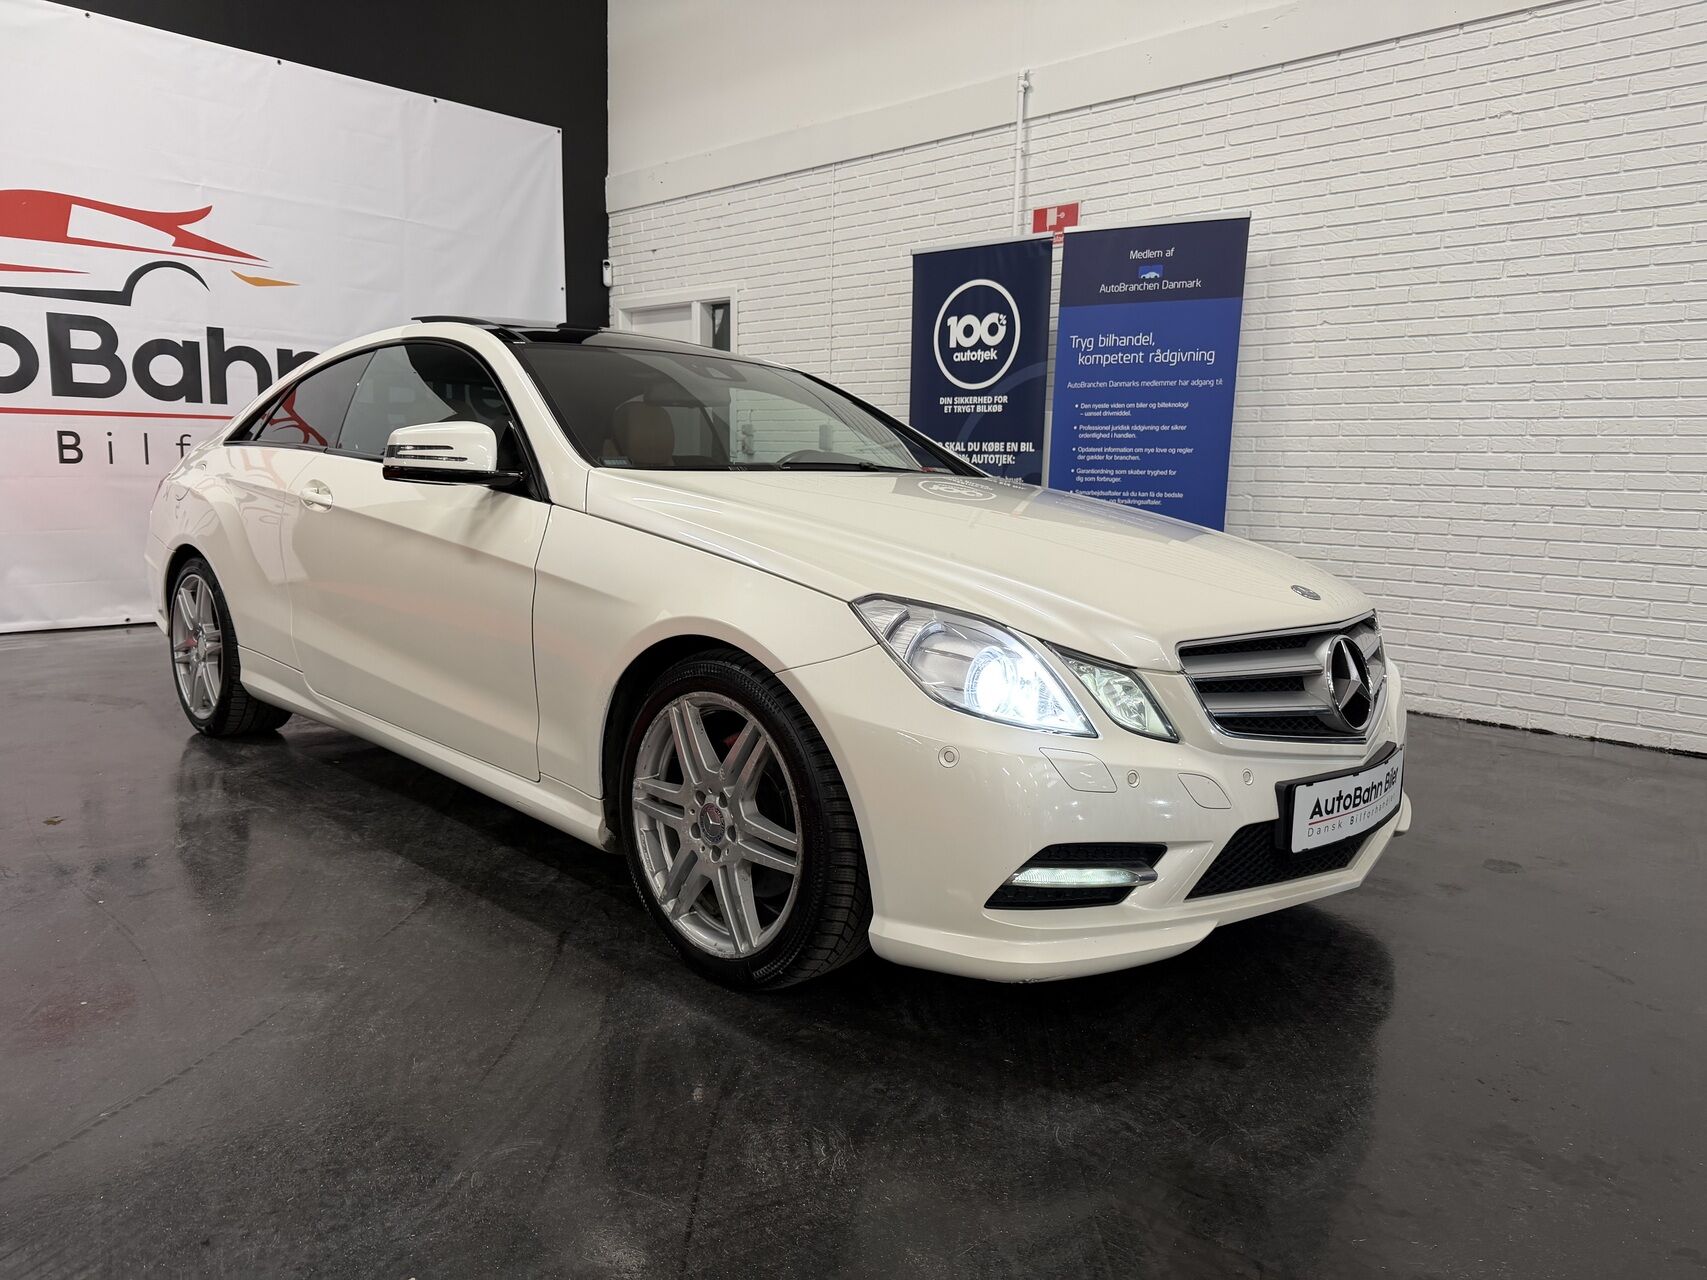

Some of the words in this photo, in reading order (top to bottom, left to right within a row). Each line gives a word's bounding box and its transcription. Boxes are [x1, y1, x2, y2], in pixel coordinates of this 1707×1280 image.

[1130, 249, 1163, 260] Medlem
[1166, 247, 1176, 258] af
[1099, 280, 1160, 293] AutoBranchen
[1162, 278, 1202, 290] Danmark
[1070, 335, 1094, 352] Tryg
[1098, 332, 1155, 348] bilhandel,
[952, 348, 998, 362] autotjek
[1078, 351, 1144, 367] kompetent
[1149, 348, 1216, 366] rådgivning
[1140, 379, 1177, 387] medlemmer
[1178, 378, 1189, 386] har
[1190, 378, 1215, 388] adgang
[954, 396, 992, 404] SIKKERHED
[994, 396, 1008, 404] FOR
[944, 406, 952, 414] ET
[976, 404, 1002, 412] BILKØB
[945, 442, 966, 452] SKAL
[968, 442, 980, 452] DU
[982, 442, 1004, 452] KØBE
[1006, 442, 1018, 452] EN
[1020, 442, 1035, 452] BIL
[971, 454, 1016, 466] AUTOTJEK:
[1309, 781, 1382, 820] AutoBahn
[1384, 767, 1398, 792] Biler
[1307, 820, 1343, 838] Dansk
